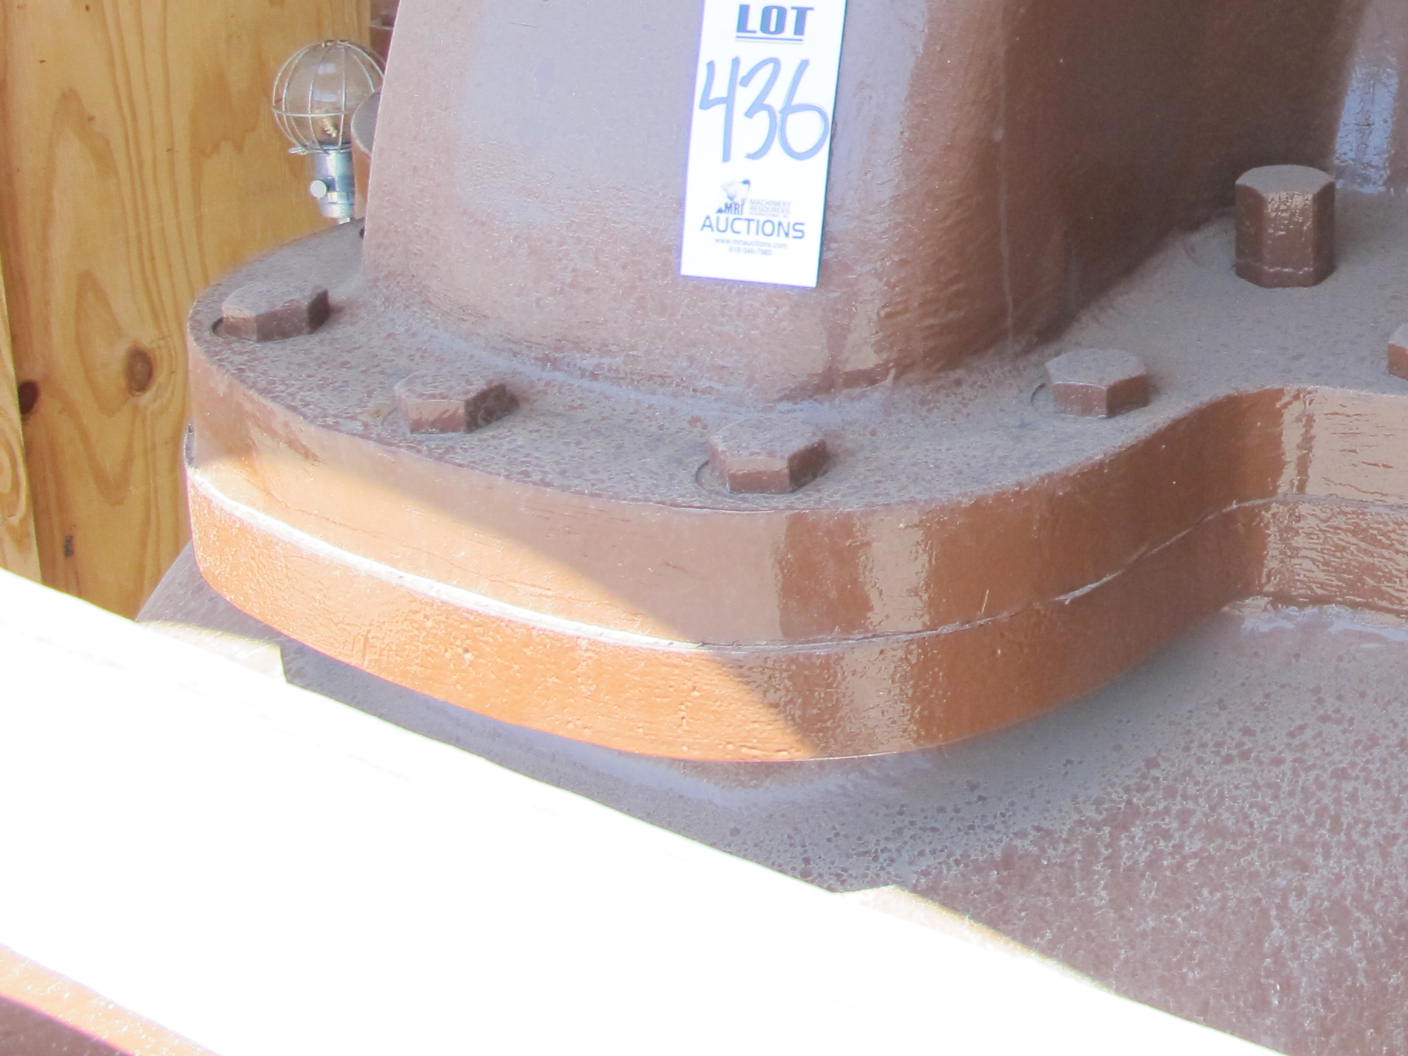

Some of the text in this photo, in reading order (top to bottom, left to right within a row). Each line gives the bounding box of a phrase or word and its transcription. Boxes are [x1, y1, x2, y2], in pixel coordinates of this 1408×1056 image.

[736, 3, 815, 37] LOT
[699, 56, 829, 163] 436
[700, 215, 806, 239] AUCTIONS
